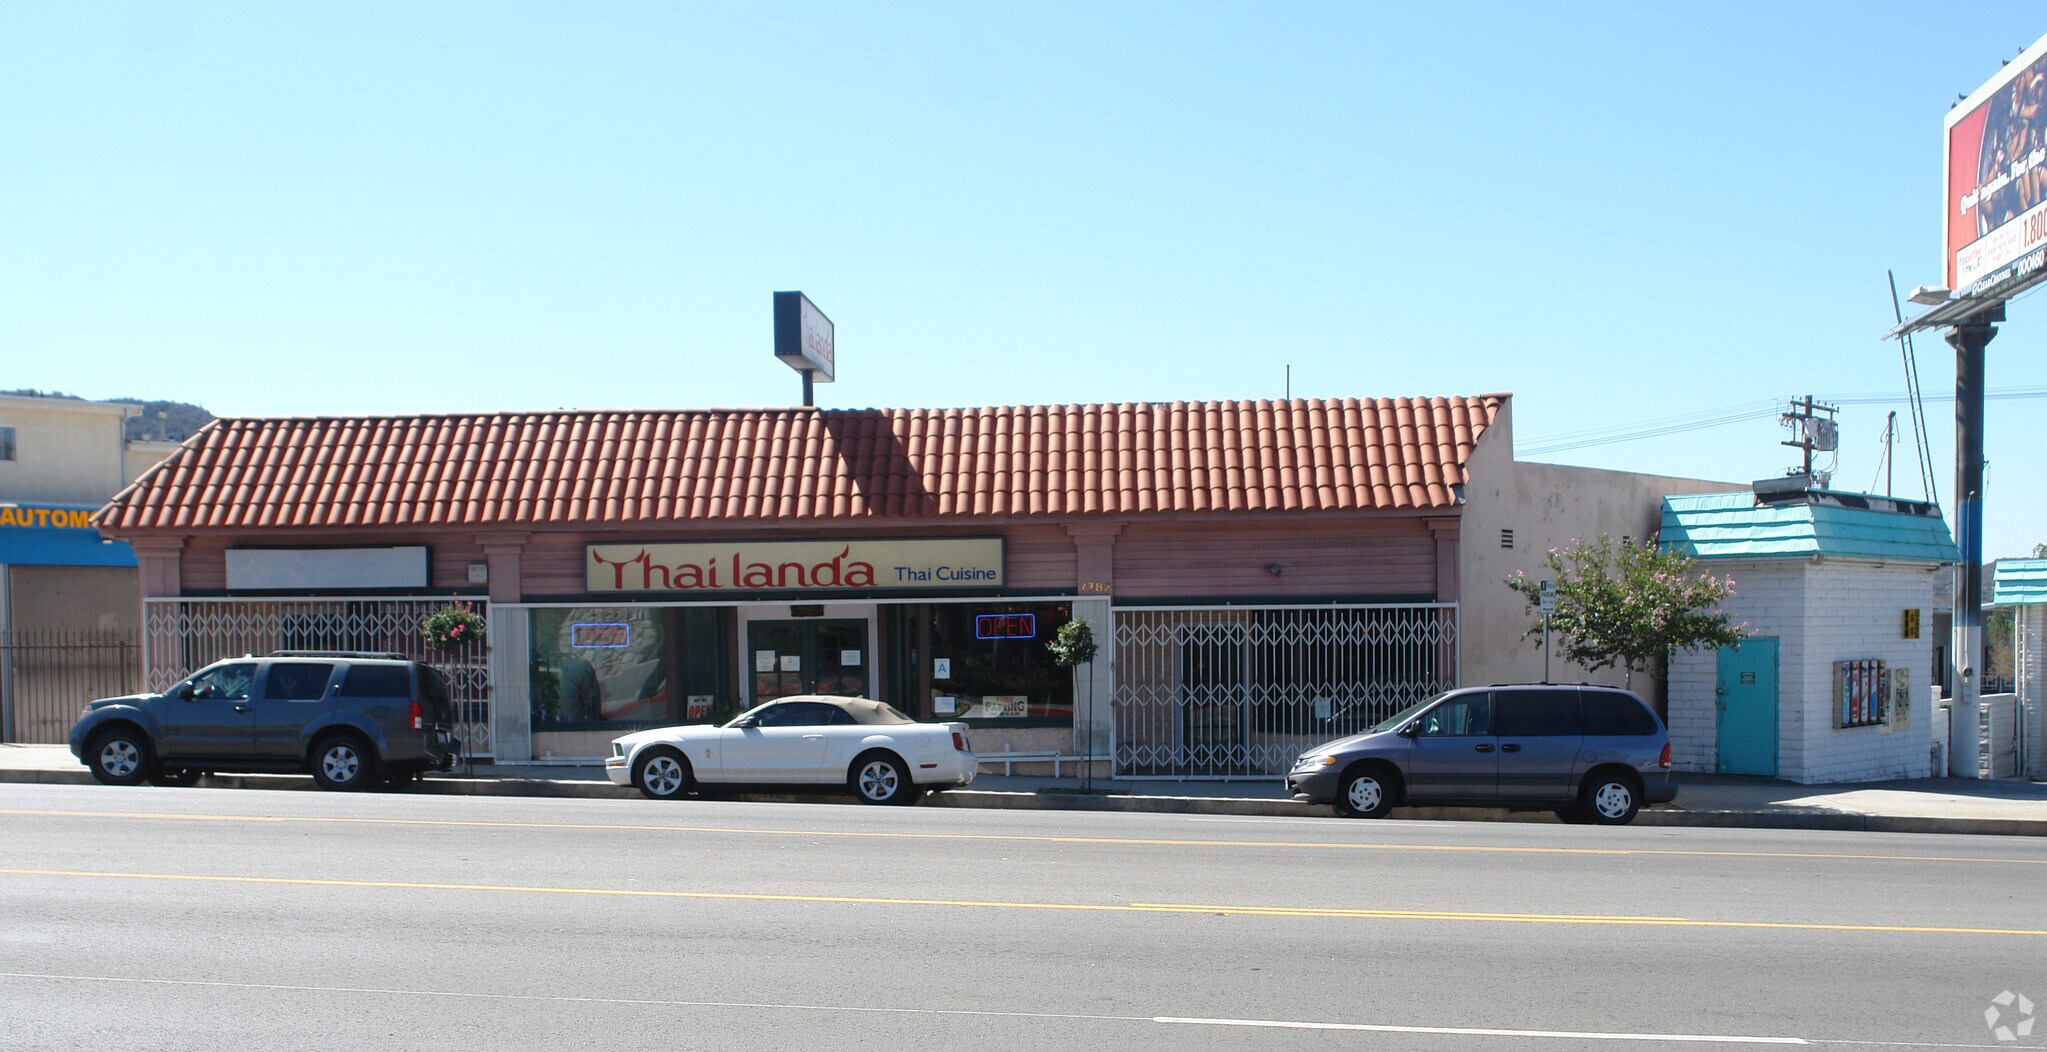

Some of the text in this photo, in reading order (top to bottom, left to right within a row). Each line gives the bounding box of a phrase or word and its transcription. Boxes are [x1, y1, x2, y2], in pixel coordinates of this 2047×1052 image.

[1961, 147, 2046, 216] Quit again. For the
[894, 566, 931, 582] Thai
[935, 565, 997, 581] Cuisine
[1081, 582, 1111, 592] 7782
[978, 616, 1033, 637] OPEN
[938, 662, 947, 673] A
[985, 701, 1025, 712] PARKING
